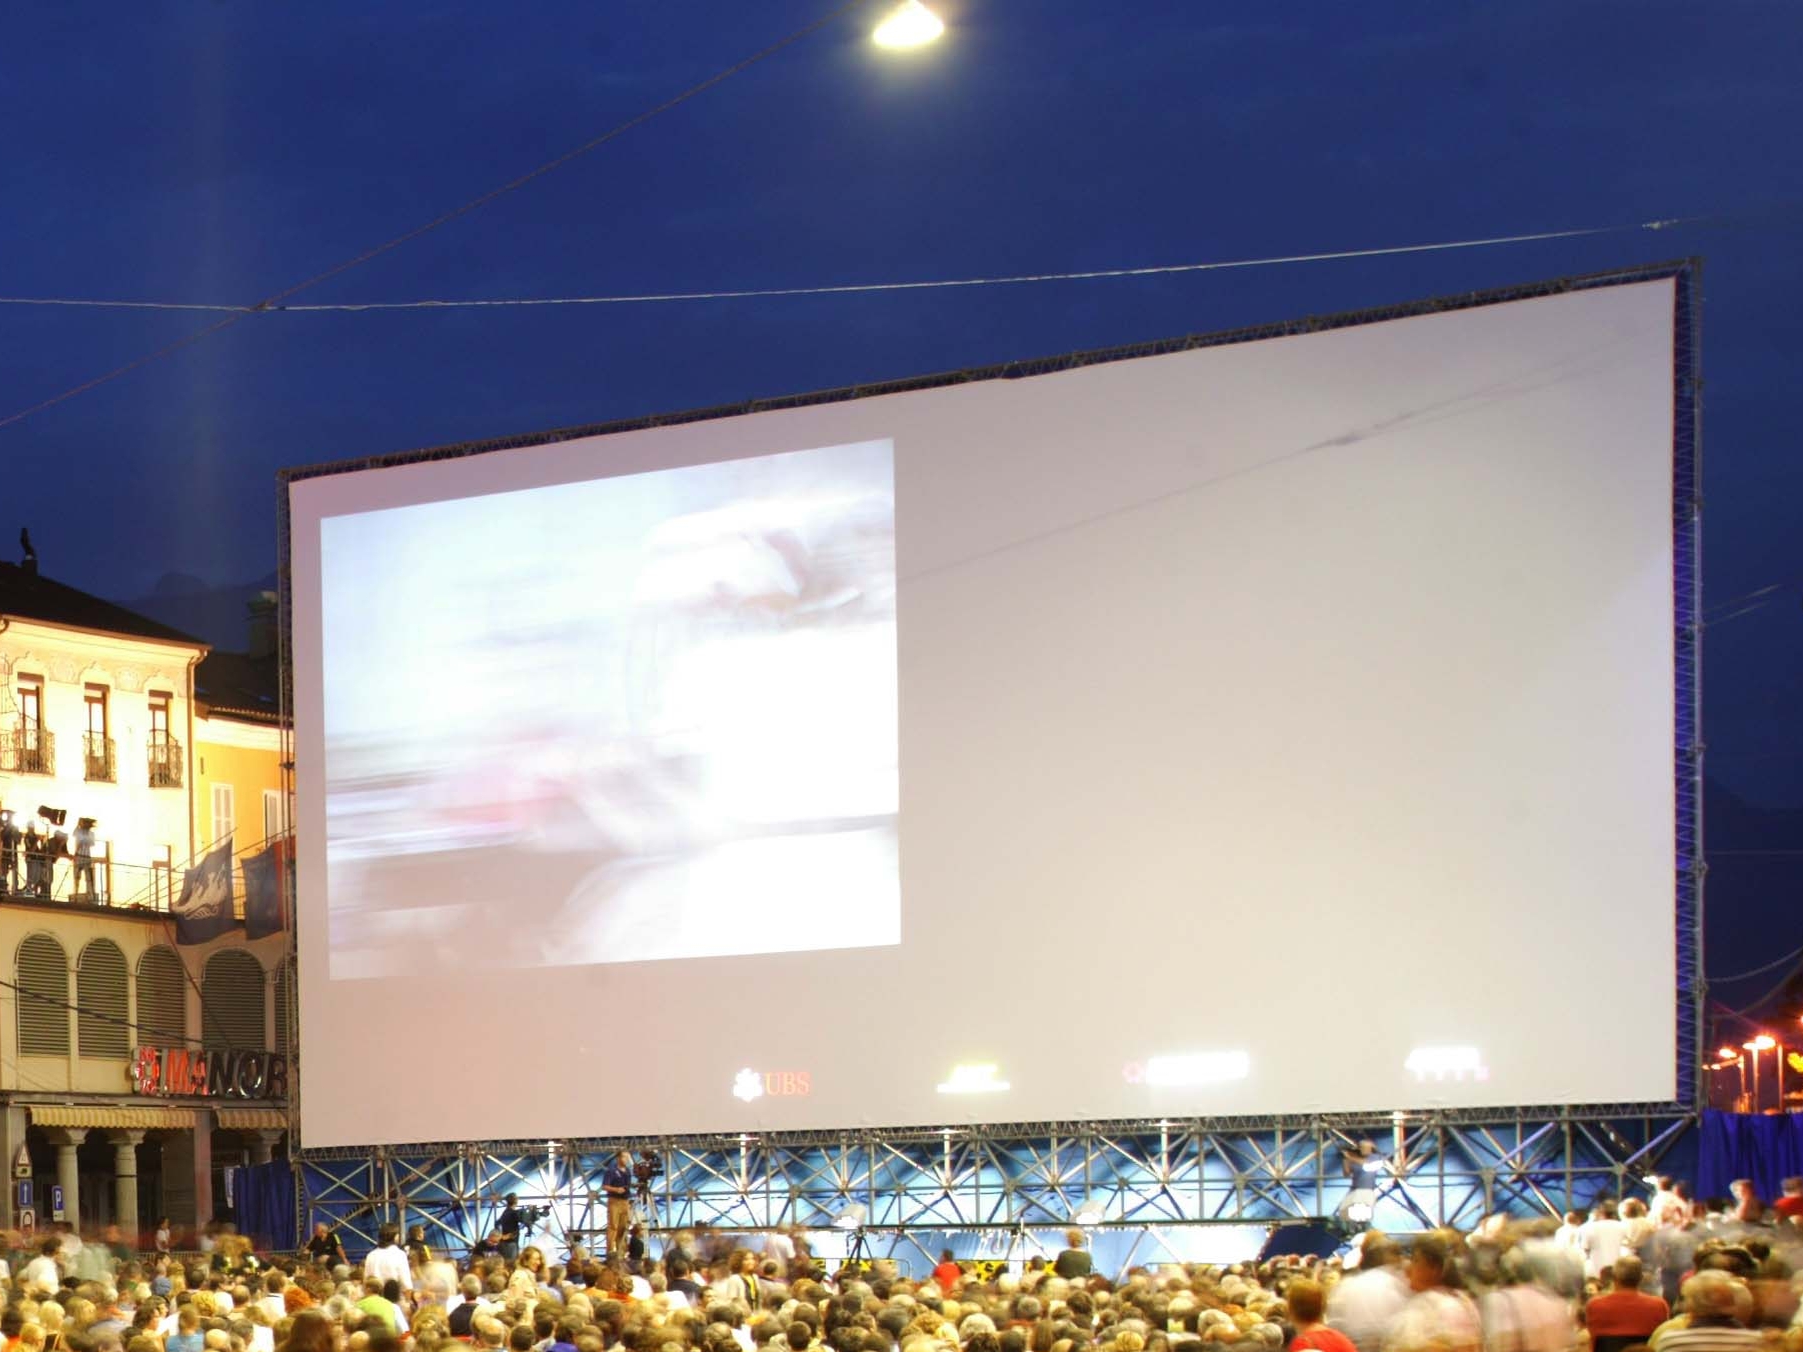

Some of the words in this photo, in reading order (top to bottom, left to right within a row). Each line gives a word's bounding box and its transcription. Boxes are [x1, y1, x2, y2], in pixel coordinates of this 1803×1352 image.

[161, 1048, 288, 1098] MANOR
[765, 1072, 810, 1096] UBS
[55, 1191, 62, 1208] P
